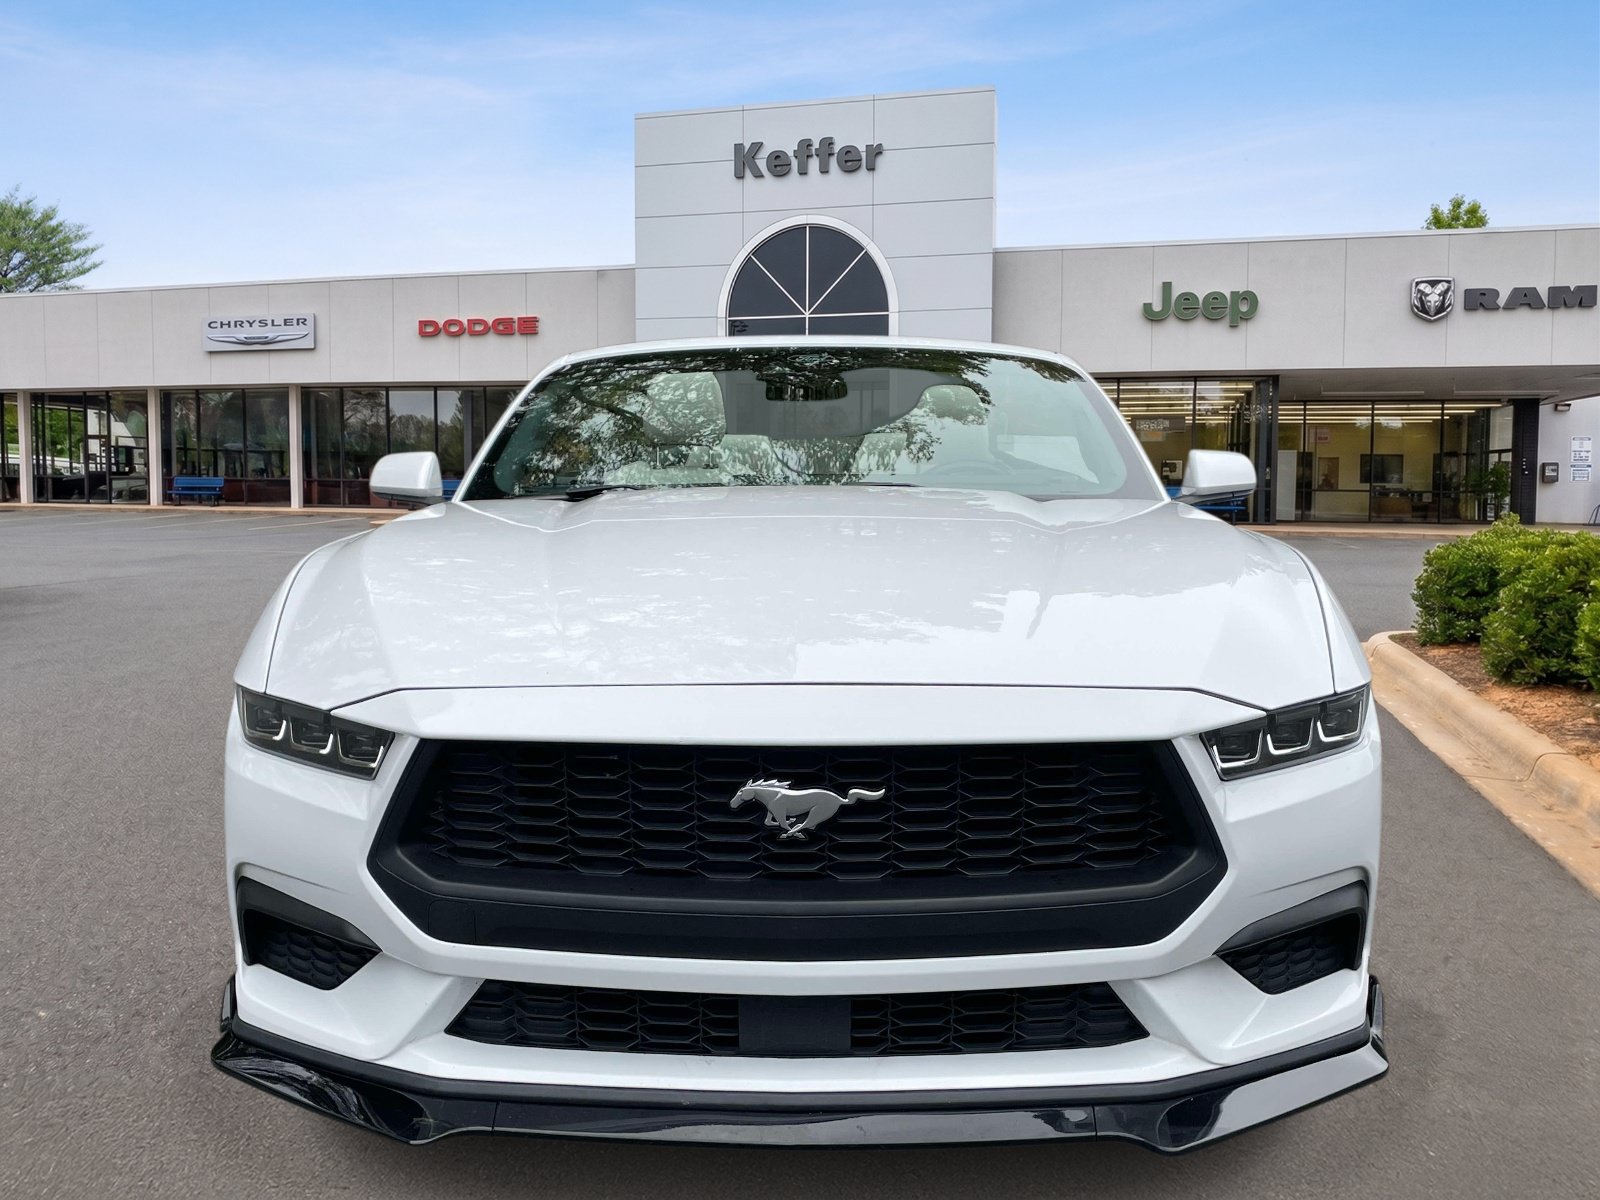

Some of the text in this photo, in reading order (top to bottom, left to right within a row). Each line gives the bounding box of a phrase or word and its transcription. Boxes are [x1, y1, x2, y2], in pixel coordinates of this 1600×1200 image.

[733, 137, 883, 179] Keffer
[1142, 281, 1259, 327] Jeep
[1464, 285, 1598, 310] RAM
[207, 317, 308, 329] CHRYSLER
[418, 316, 539, 336] DODGE
